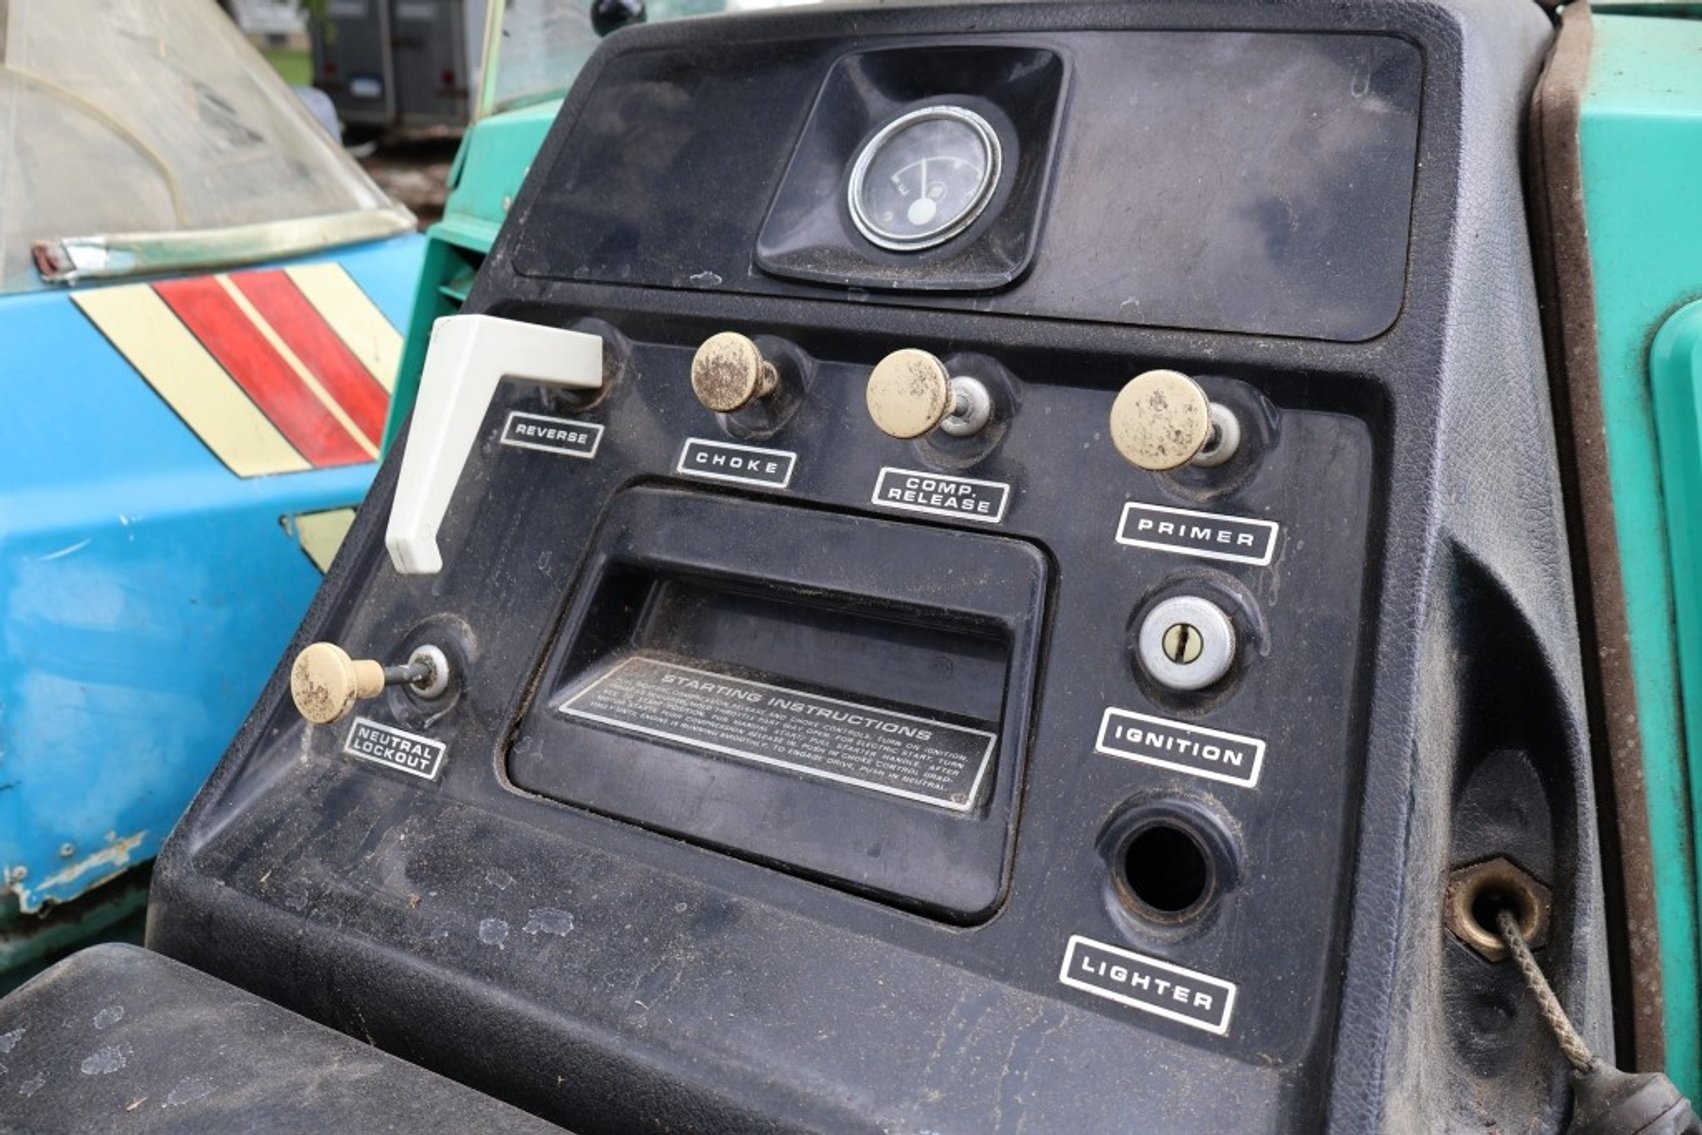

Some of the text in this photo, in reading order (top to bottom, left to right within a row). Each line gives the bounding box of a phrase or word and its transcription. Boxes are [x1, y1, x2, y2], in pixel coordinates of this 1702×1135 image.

[515, 423, 588, 444] REVERSE
[695, 451, 778, 473] CHOKE
[887, 487, 991, 513] RELEASE
[906, 477, 977, 498] COMP.
[1137, 518, 1255, 546] PRIMER
[658, 674, 764, 702] STARTING
[765, 697, 934, 741] INSTRUCTIONS
[358, 727, 432, 759] NEUTRAL
[765, 711, 788, 720] AND
[875, 736, 902, 746] TURN
[904, 742, 921, 751] ON
[353, 738, 430, 770] LOCKOUT
[771, 744, 786, 752] TO
[833, 734, 854, 743] FOR
[937, 758, 965, 769] TURN
[1114, 725, 1244, 766] IGNITION
[874, 760, 919, 776] CONTROL
[928, 764, 960, 777] AFTER
[1081, 956, 1213, 1010] LIGHTER
